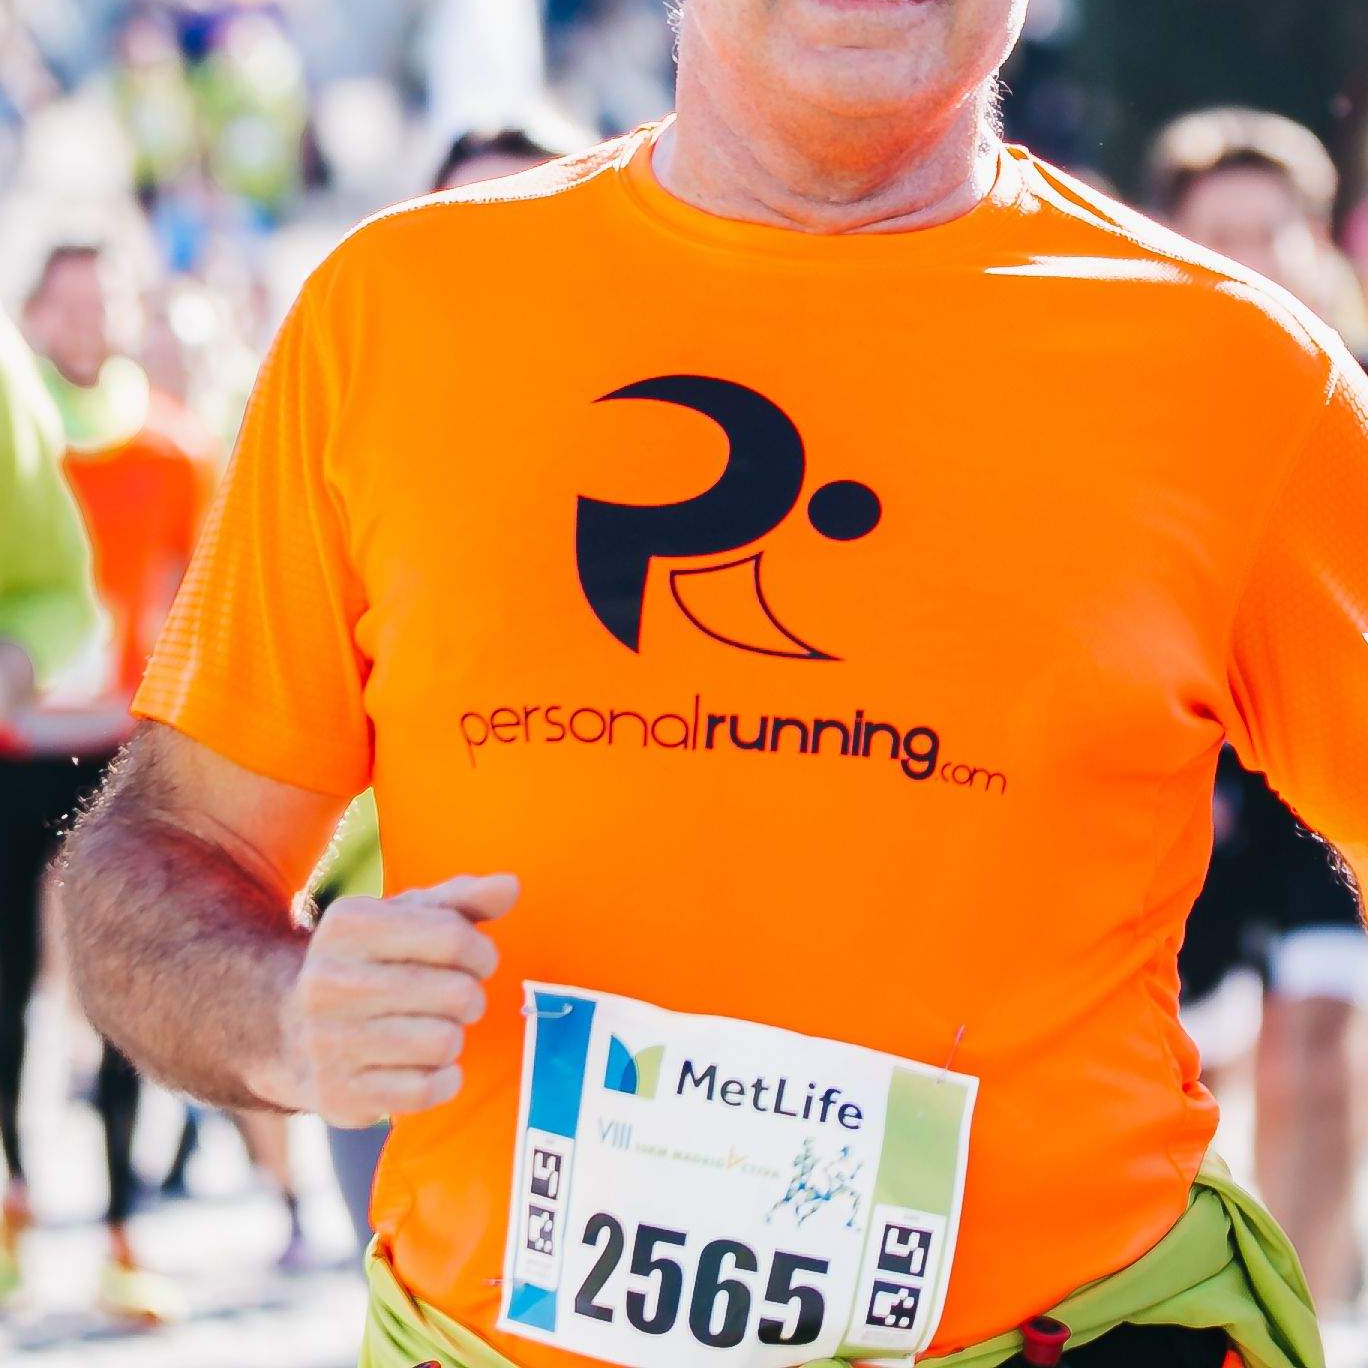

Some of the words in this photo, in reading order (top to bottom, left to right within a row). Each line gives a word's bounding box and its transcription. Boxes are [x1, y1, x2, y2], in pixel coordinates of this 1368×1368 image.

[677, 1059, 863, 1130] MetLife
[598, 1116, 632, 1151] VIII
[574, 1211, 830, 1349] 2565
